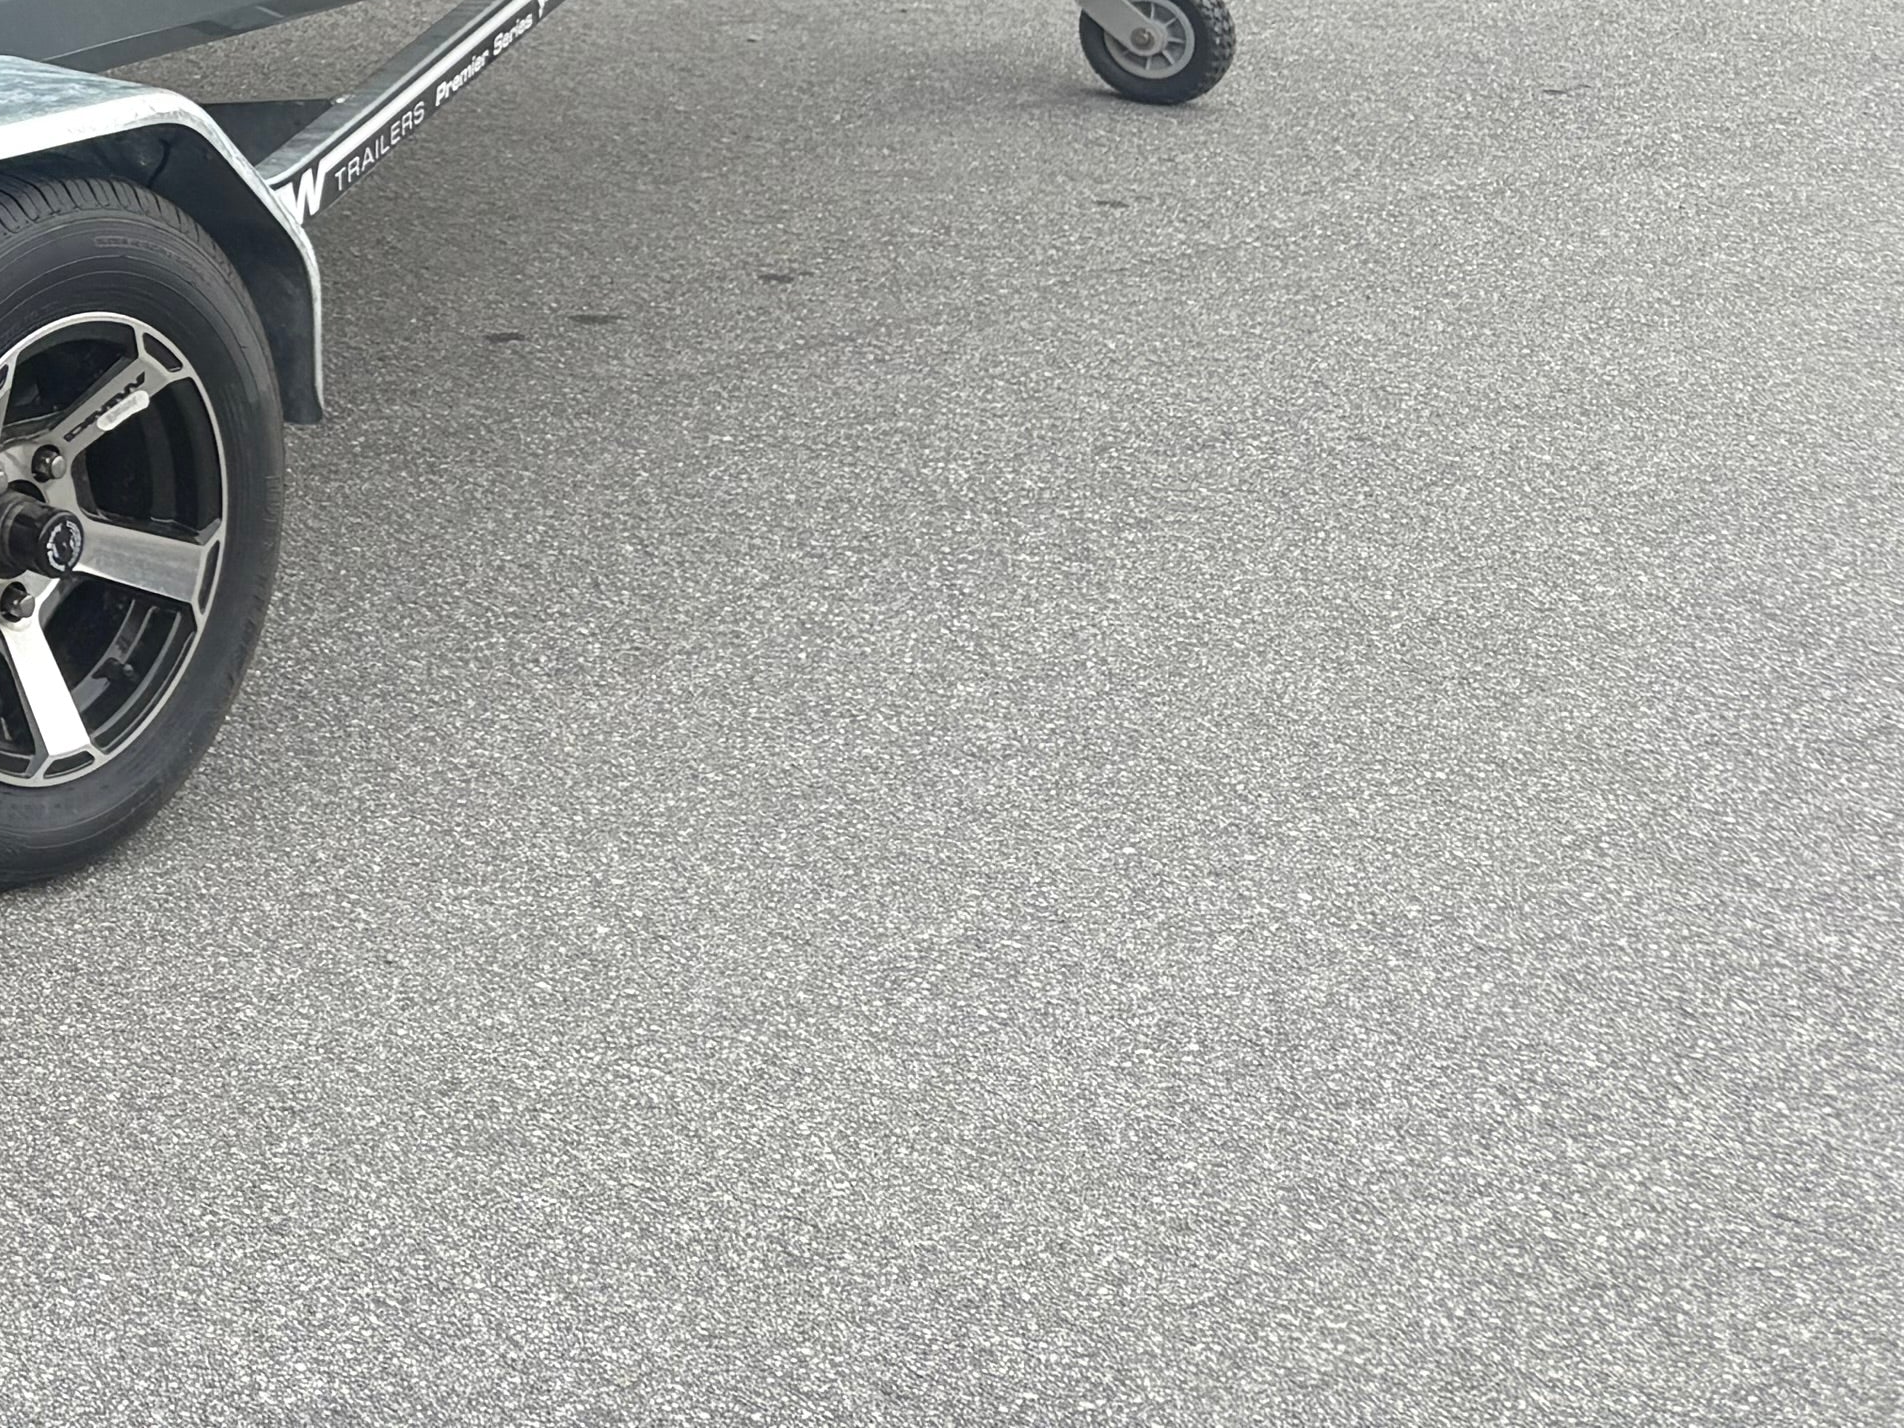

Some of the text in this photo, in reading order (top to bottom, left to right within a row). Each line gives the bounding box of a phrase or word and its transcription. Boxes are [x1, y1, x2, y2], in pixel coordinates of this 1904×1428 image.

[334, 100, 425, 192] TRAILERS
[434, 49, 490, 107] Premier
[492, 13, 534, 57] Series
